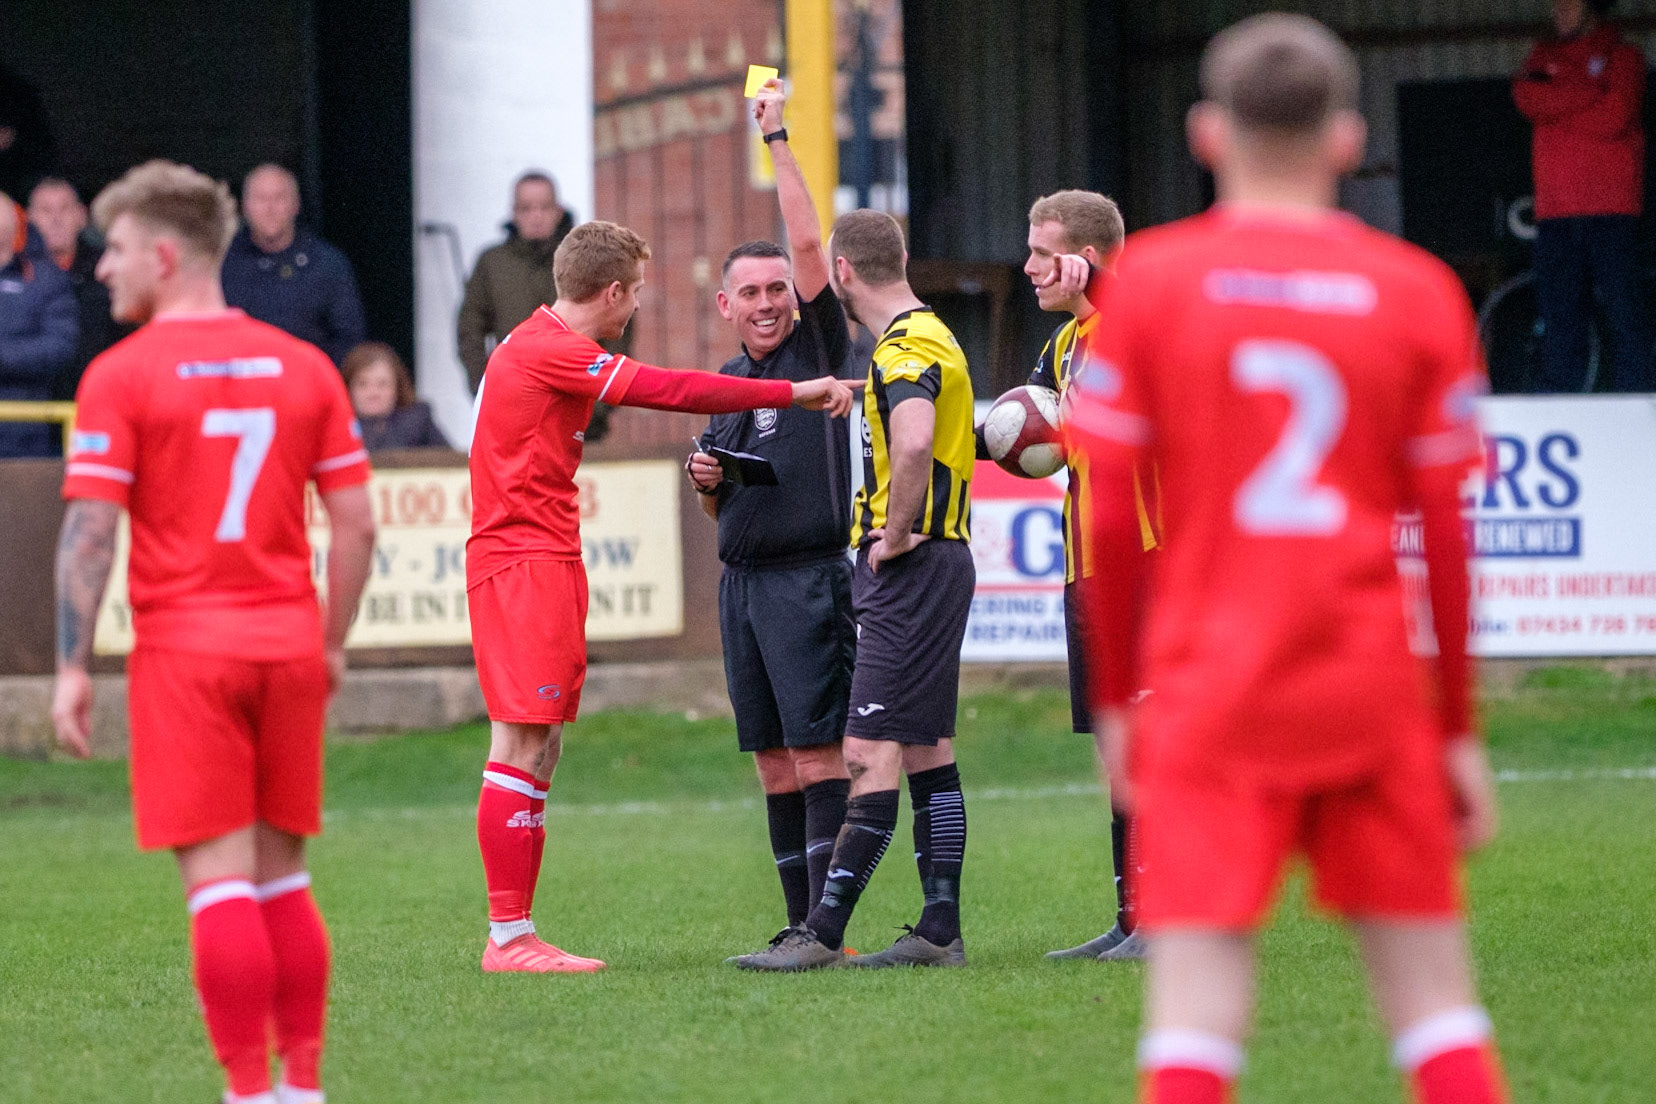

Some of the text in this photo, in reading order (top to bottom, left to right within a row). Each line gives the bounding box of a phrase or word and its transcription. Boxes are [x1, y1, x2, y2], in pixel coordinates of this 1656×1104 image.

[1231, 338, 1348, 537] 2
[1466, 433, 1579, 508] RS
[201, 408, 276, 541] 7
[379, 483, 447, 525] 100
[1011, 507, 1069, 577] G
[1478, 574, 1549, 598] REPAIRS
